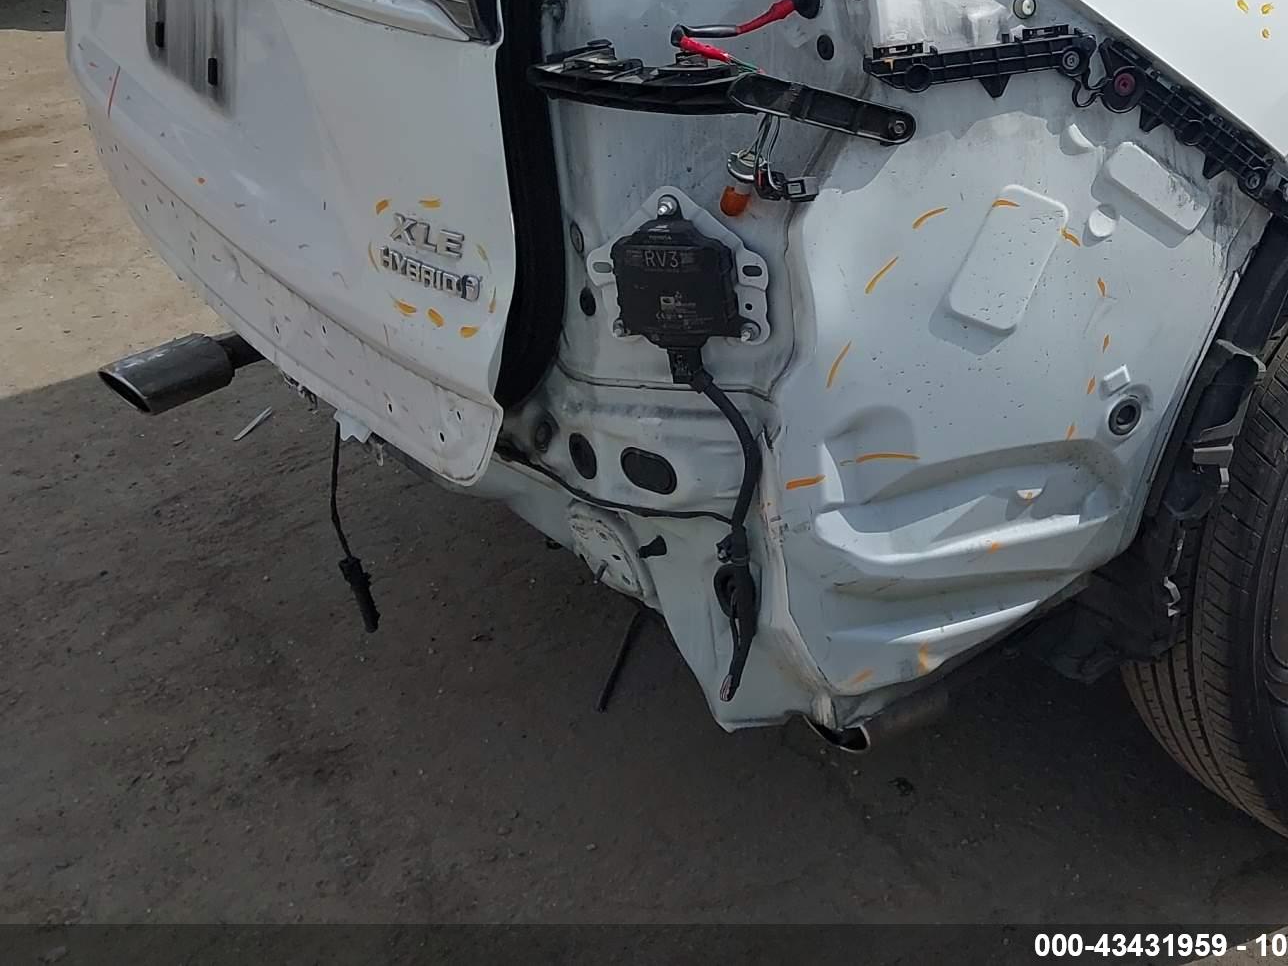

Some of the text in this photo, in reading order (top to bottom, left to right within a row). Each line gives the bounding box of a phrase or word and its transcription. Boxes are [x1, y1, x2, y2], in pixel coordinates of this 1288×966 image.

[389, 212, 465, 259] XLE
[644, 250, 679, 268] RV3
[379, 245, 464, 297] HYBRID
